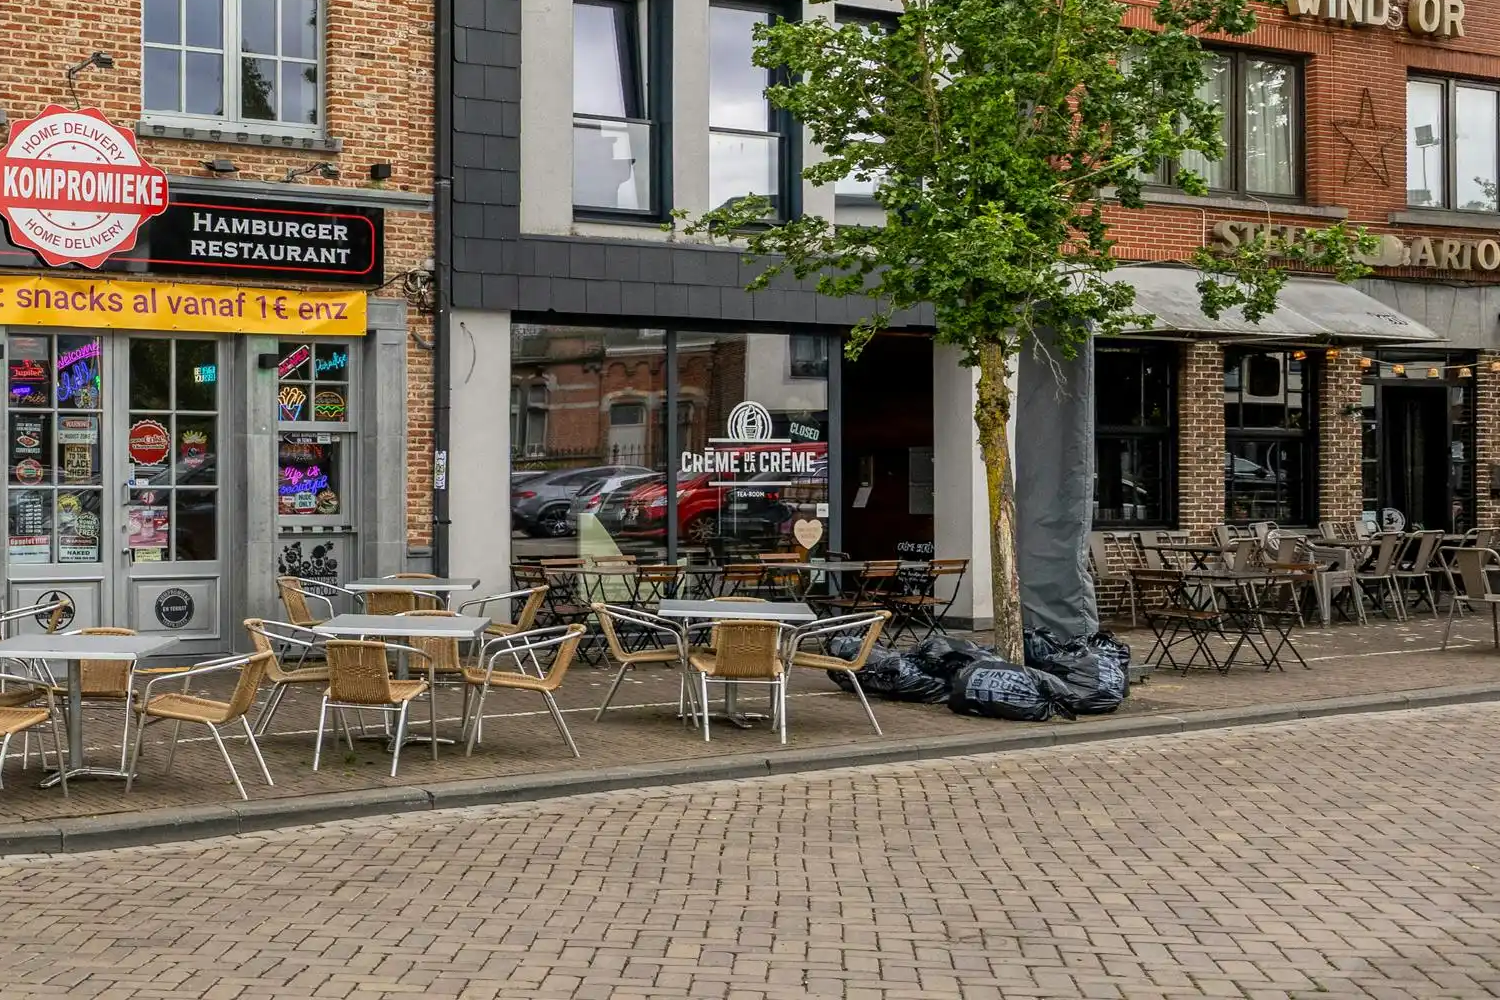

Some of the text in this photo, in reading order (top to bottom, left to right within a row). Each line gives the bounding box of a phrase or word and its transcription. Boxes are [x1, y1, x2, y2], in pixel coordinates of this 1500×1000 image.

[21, 122, 126, 162] HOME DELIVERY
[3, 165, 163, 206] KOMPROMIEKE
[25, 218, 125, 250] HOME DELIVERY
[192, 212, 349, 242] HAMBURGER
[190, 239, 351, 265] RESTAURANT
[16, 285, 123, 312] snacks
[133, 287, 157, 314] al
[166, 291, 246, 318] vanaf
[257, 295, 290, 320] 1€
[298, 301, 349, 321] enz
[789, 422, 820, 440] CLOSED
[67, 460, 90, 468] PLACE
[744, 452, 756, 462] DE
[744, 462, 756, 473] LA
